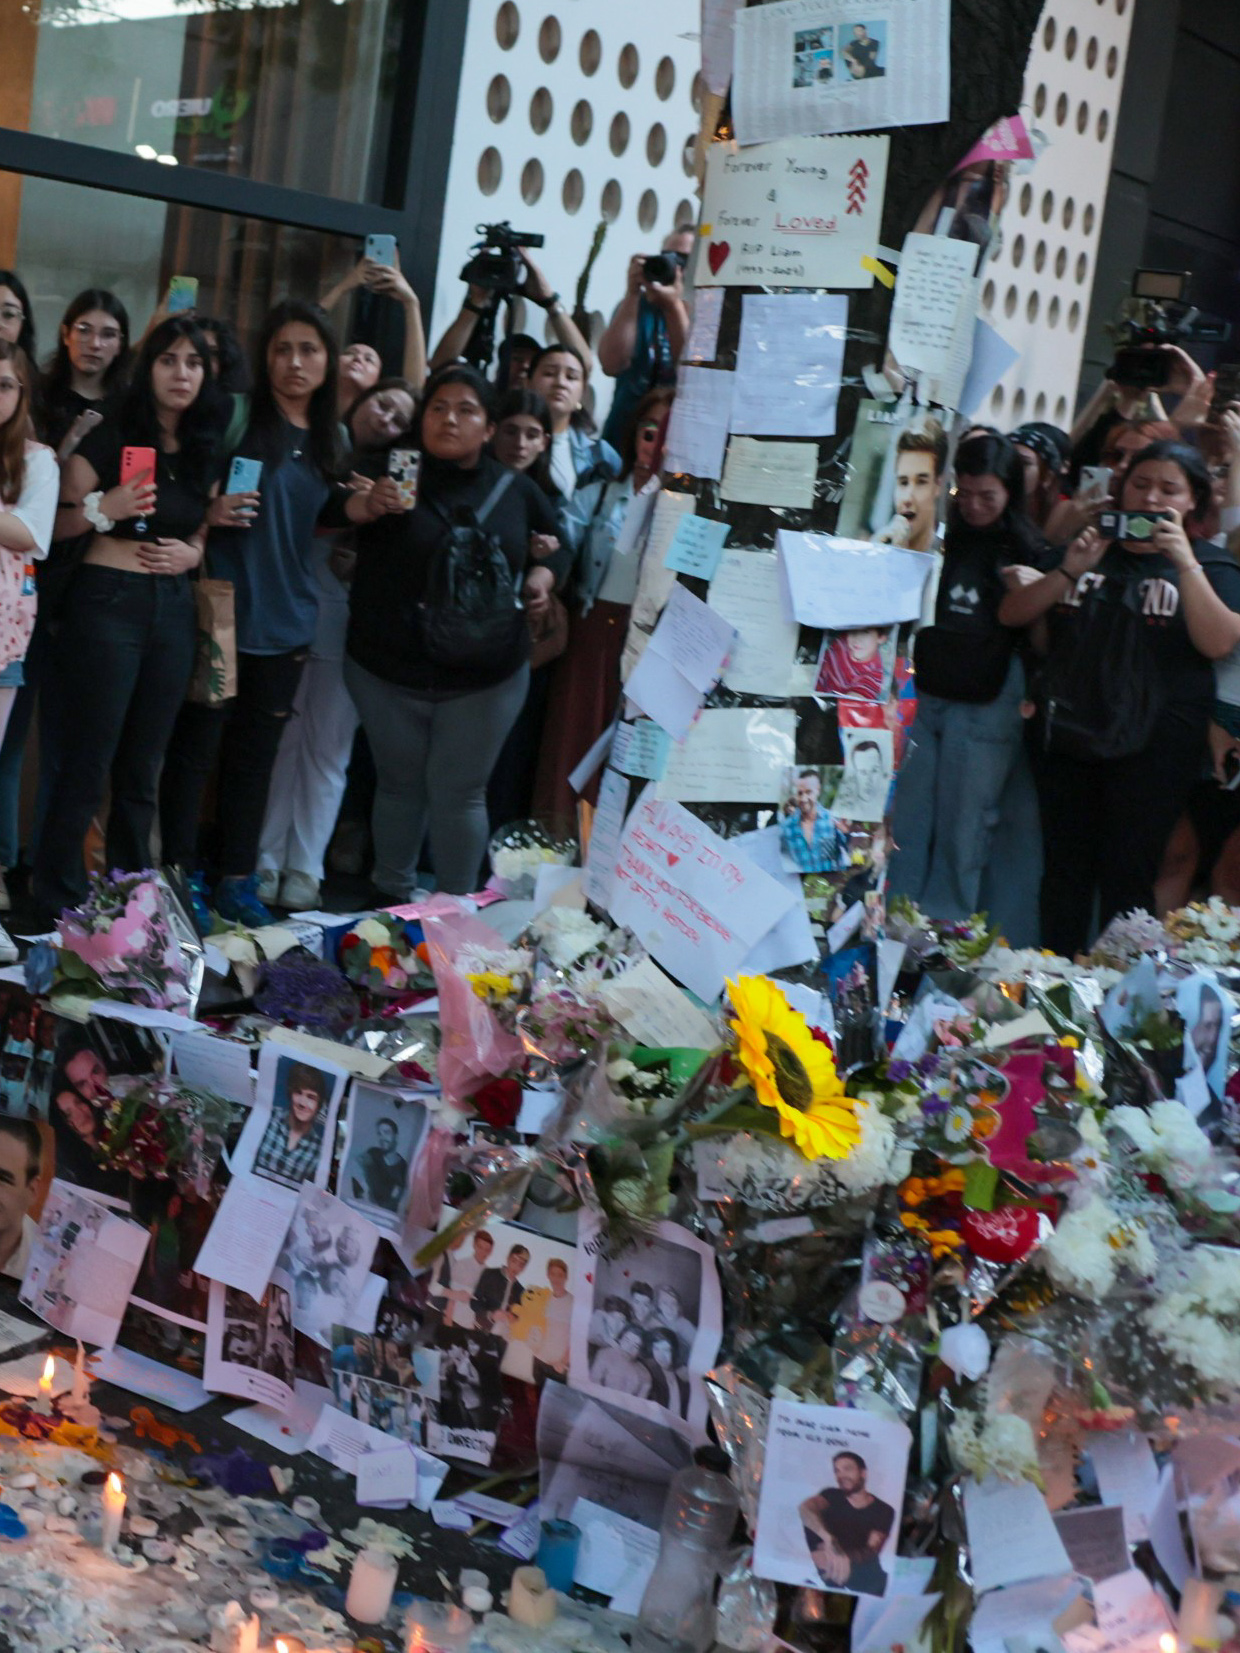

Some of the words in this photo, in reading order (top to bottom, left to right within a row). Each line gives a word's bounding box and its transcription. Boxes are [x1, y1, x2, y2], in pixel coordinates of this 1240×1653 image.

[724, 154, 772, 174] Forever
[785, 157, 828, 180] Young
[717, 210, 760, 227] Forever
[775, 212, 838, 230] Loved
[740, 243, 764, 256] RIP
[771, 245, 803, 257] Liam
